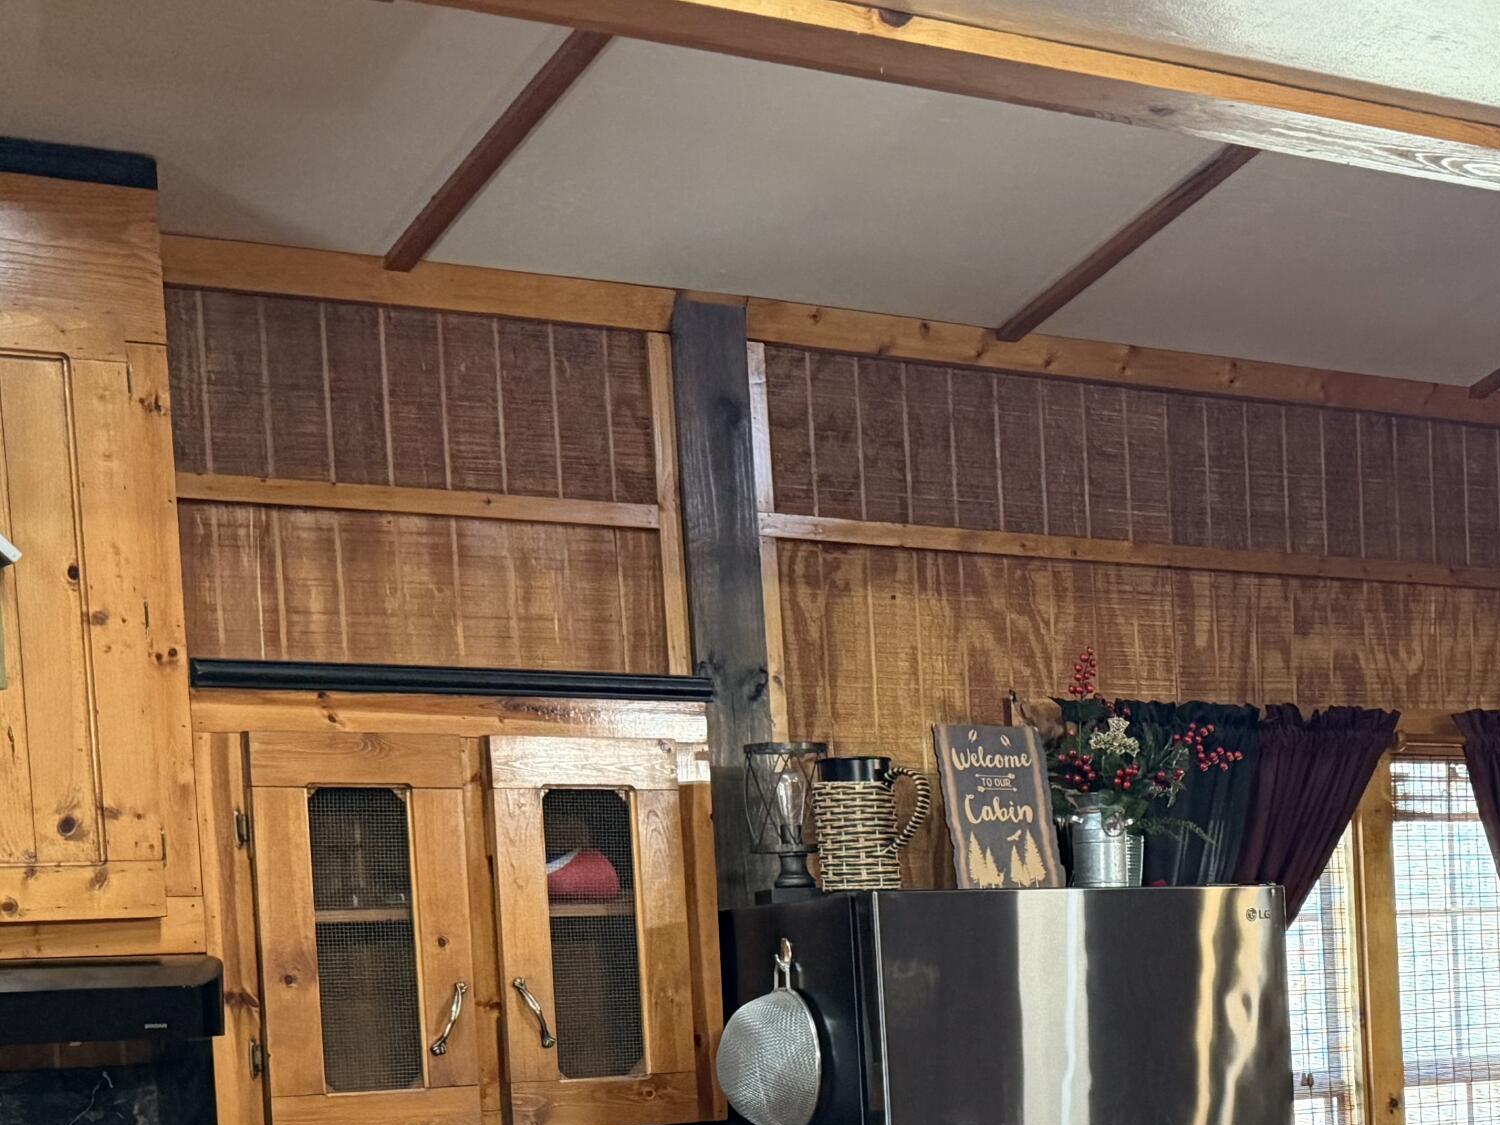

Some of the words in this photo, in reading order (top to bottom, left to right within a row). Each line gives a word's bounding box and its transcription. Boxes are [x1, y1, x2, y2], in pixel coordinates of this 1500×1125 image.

[952, 746, 1032, 771] Welcome
[981, 777, 993, 787] TO
[994, 777, 1012, 788] OUR
[965, 794, 1034, 824] Cabin
[1258, 908, 1271, 919] LG
